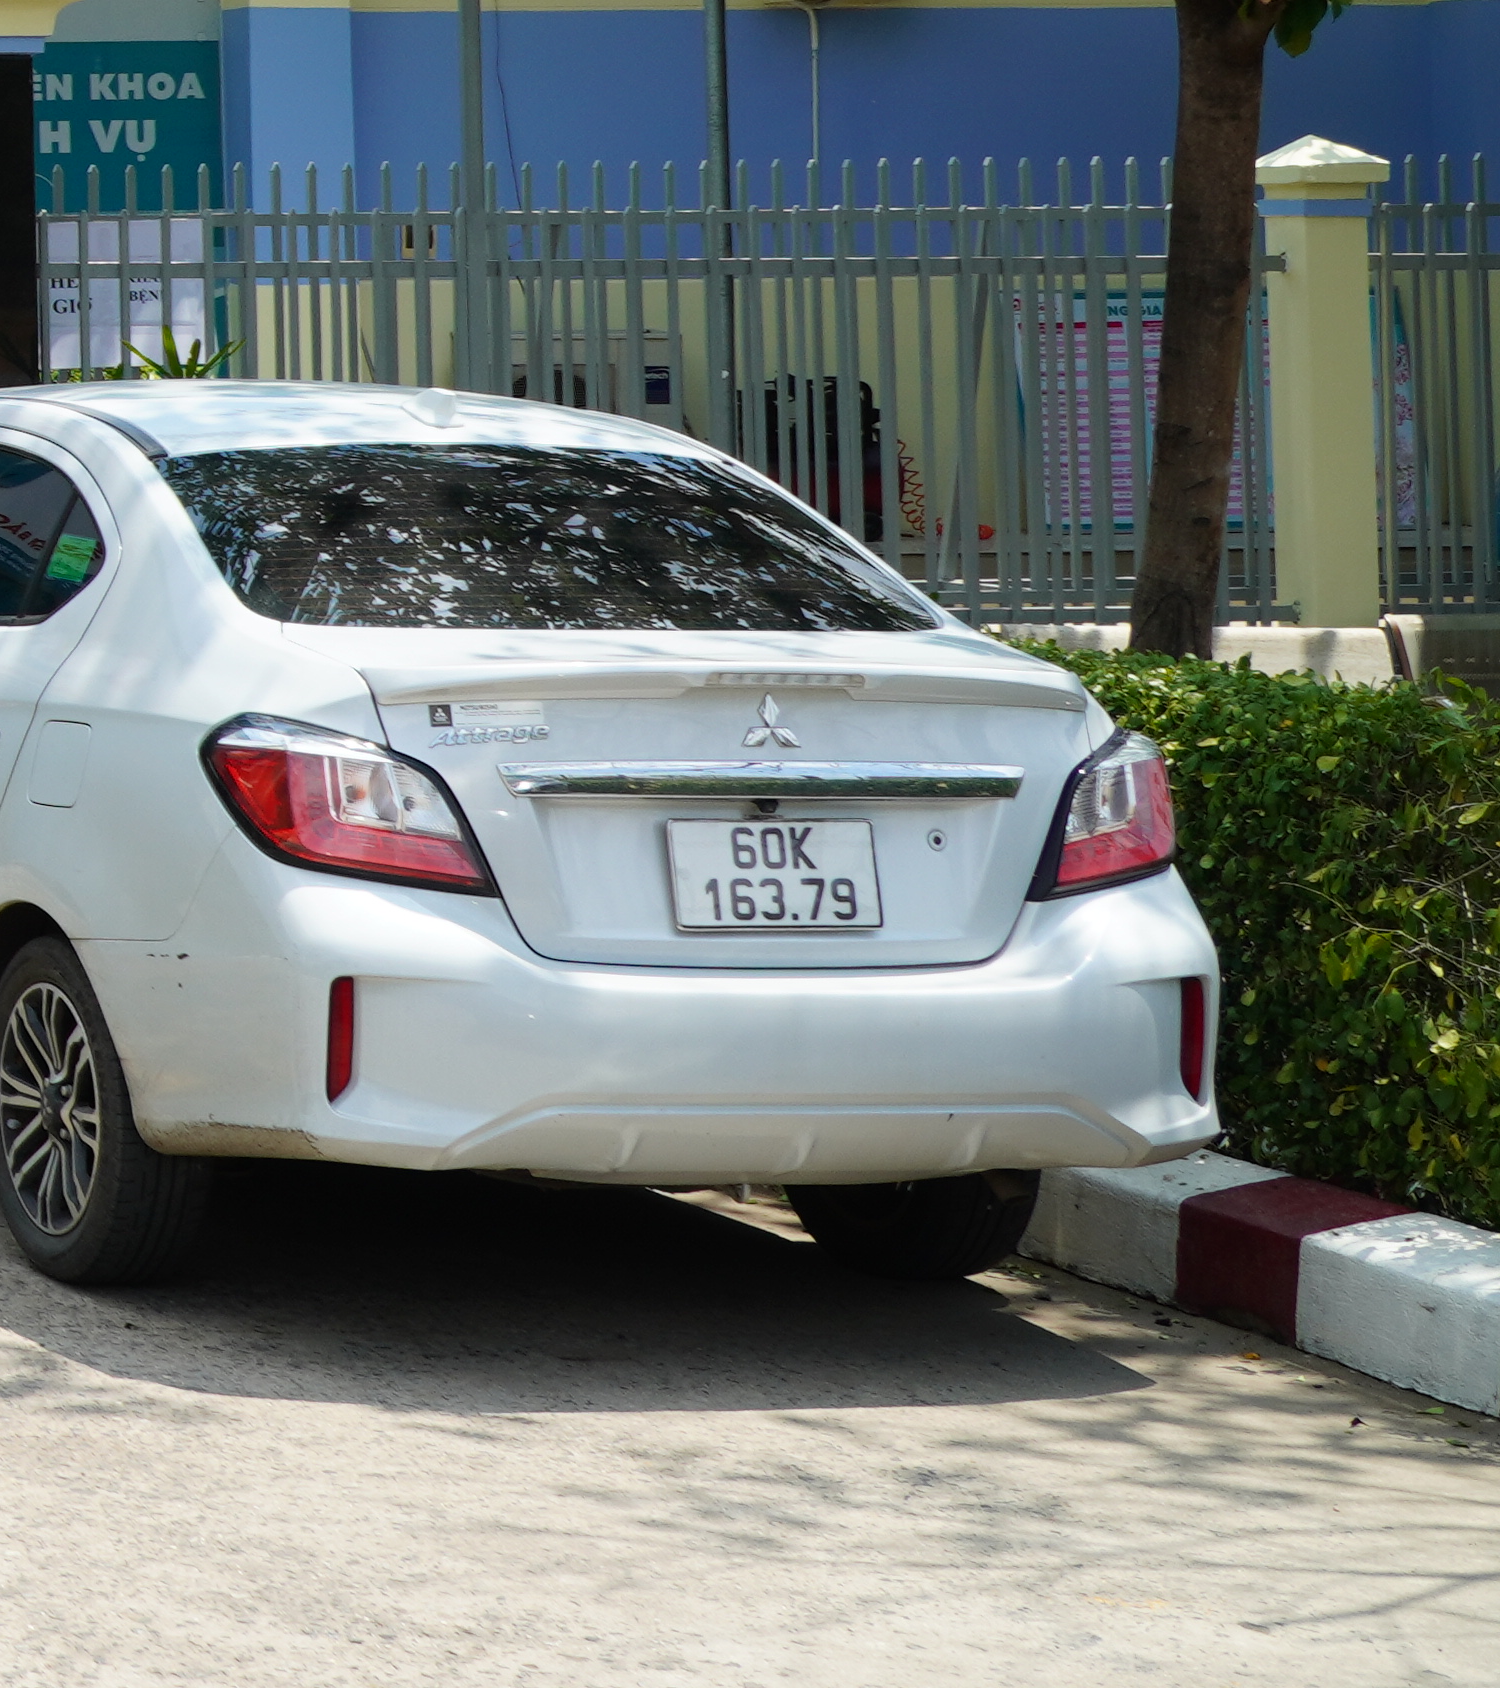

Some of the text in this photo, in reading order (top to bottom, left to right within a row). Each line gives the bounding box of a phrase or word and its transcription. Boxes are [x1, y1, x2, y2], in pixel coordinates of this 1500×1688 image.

[89, 72, 207, 102] KHOA
[88, 119, 157, 163] VỤ
[129, 288, 161, 304] BỆN
[427, 724, 551, 749] Attrage
[730, 826, 818, 870] 60K
[704, 877, 858, 921] 163.79
